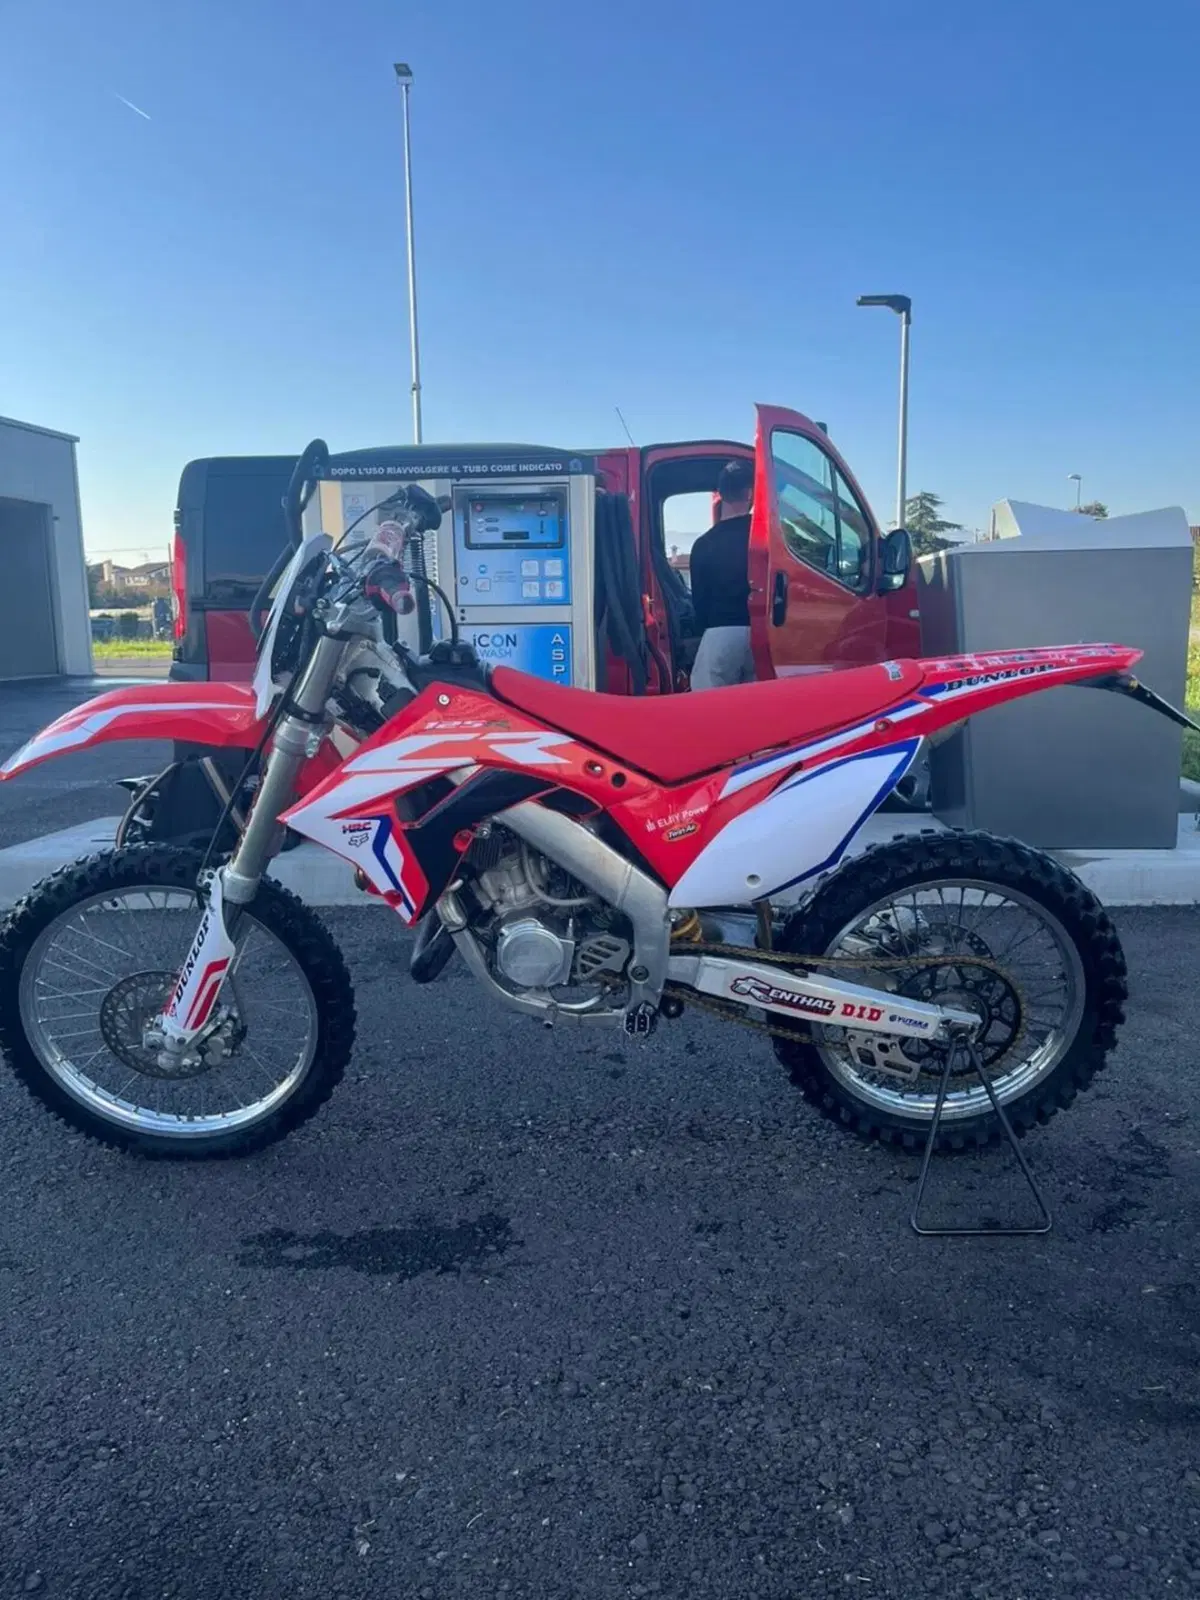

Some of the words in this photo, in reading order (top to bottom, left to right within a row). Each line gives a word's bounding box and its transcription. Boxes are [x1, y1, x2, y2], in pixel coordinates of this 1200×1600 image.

[331, 468, 356, 476] DOPO
[358, 467, 385, 475] L'USO
[386, 466, 449, 475] RIAVVOLGERE
[463, 465, 488, 473] TUBO
[490, 464, 517, 472] COME
[518, 463, 562, 472] INDICATO
[473, 633, 518, 648] iCON
[550, 632, 566, 684] ASP
[945, 664, 1056, 692] DUNLOP
[342, 821, 372, 834] HRC
[176, 914, 210, 1003] DUNLOP
[898, 1015, 929, 1029] YUTAKA
